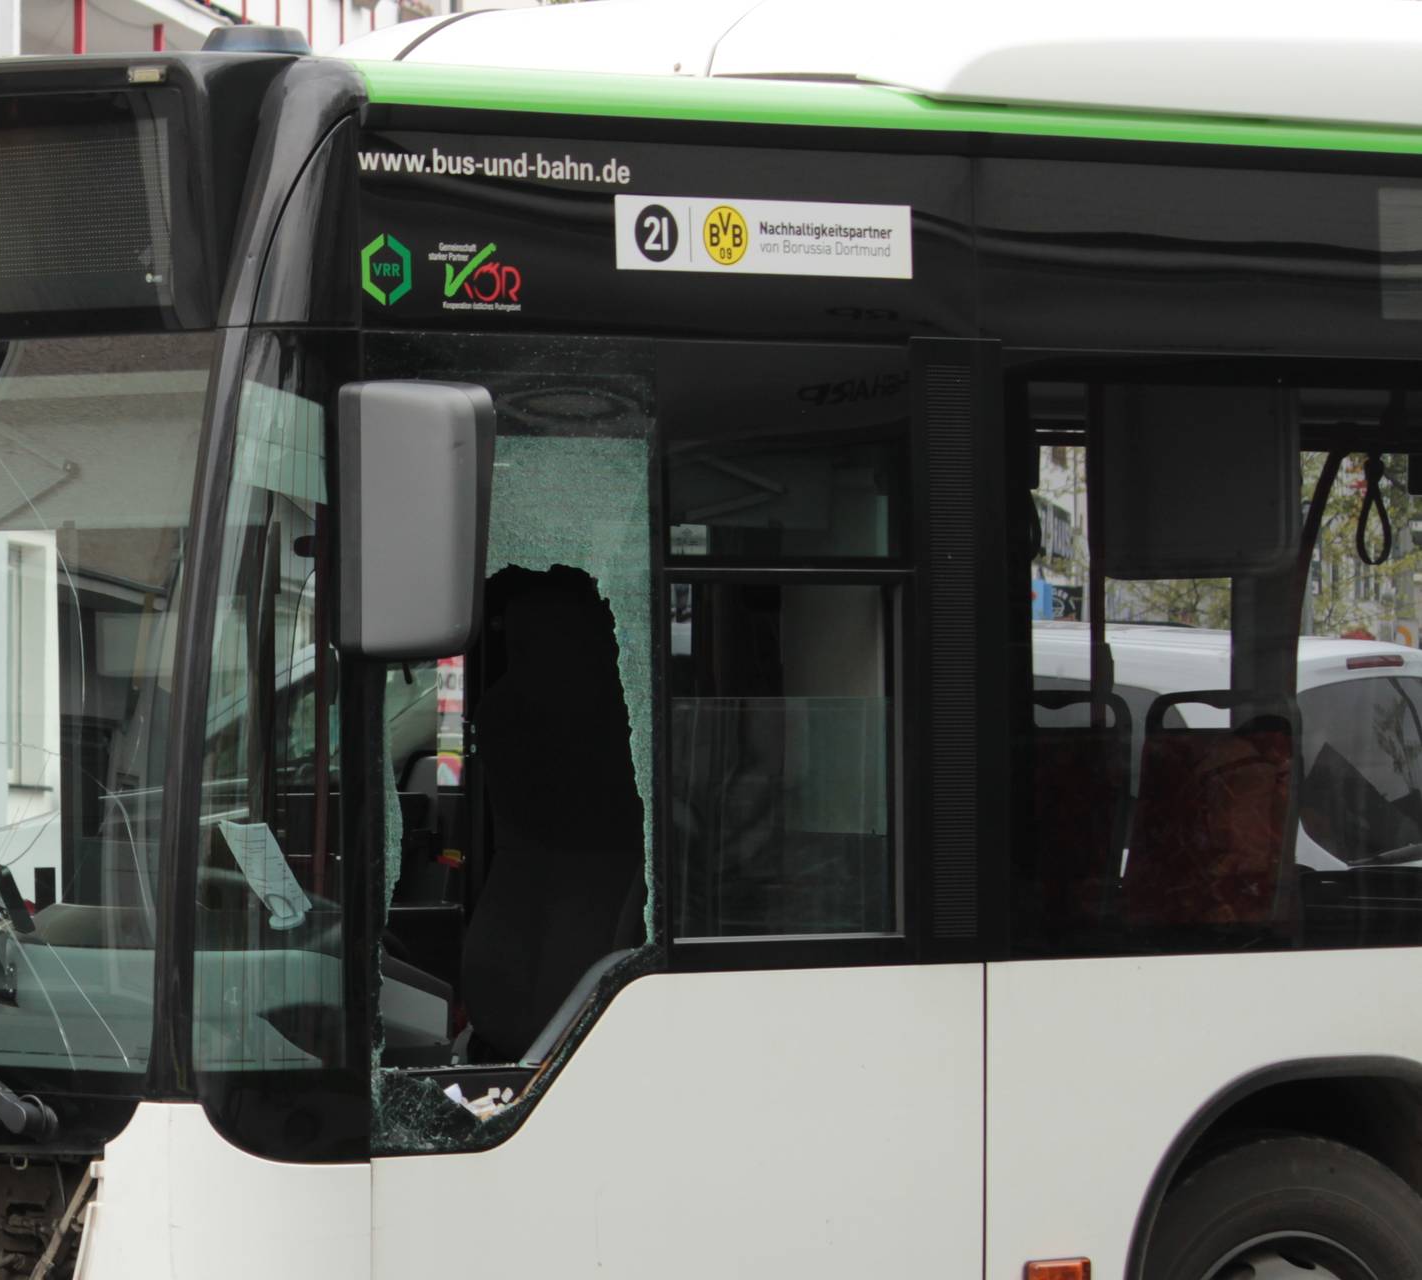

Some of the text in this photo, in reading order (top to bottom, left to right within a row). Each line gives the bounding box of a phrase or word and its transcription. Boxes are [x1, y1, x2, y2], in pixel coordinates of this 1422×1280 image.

[358, 148, 631, 184] www.bus-und-bahn.de
[709, 211, 743, 248] BVB
[758, 221, 893, 241] Nachhaltigkeitspartner
[719, 247, 733, 260] 09
[759, 239, 892, 258] von Borussia Dortmund
[372, 262, 402, 278] VRR
